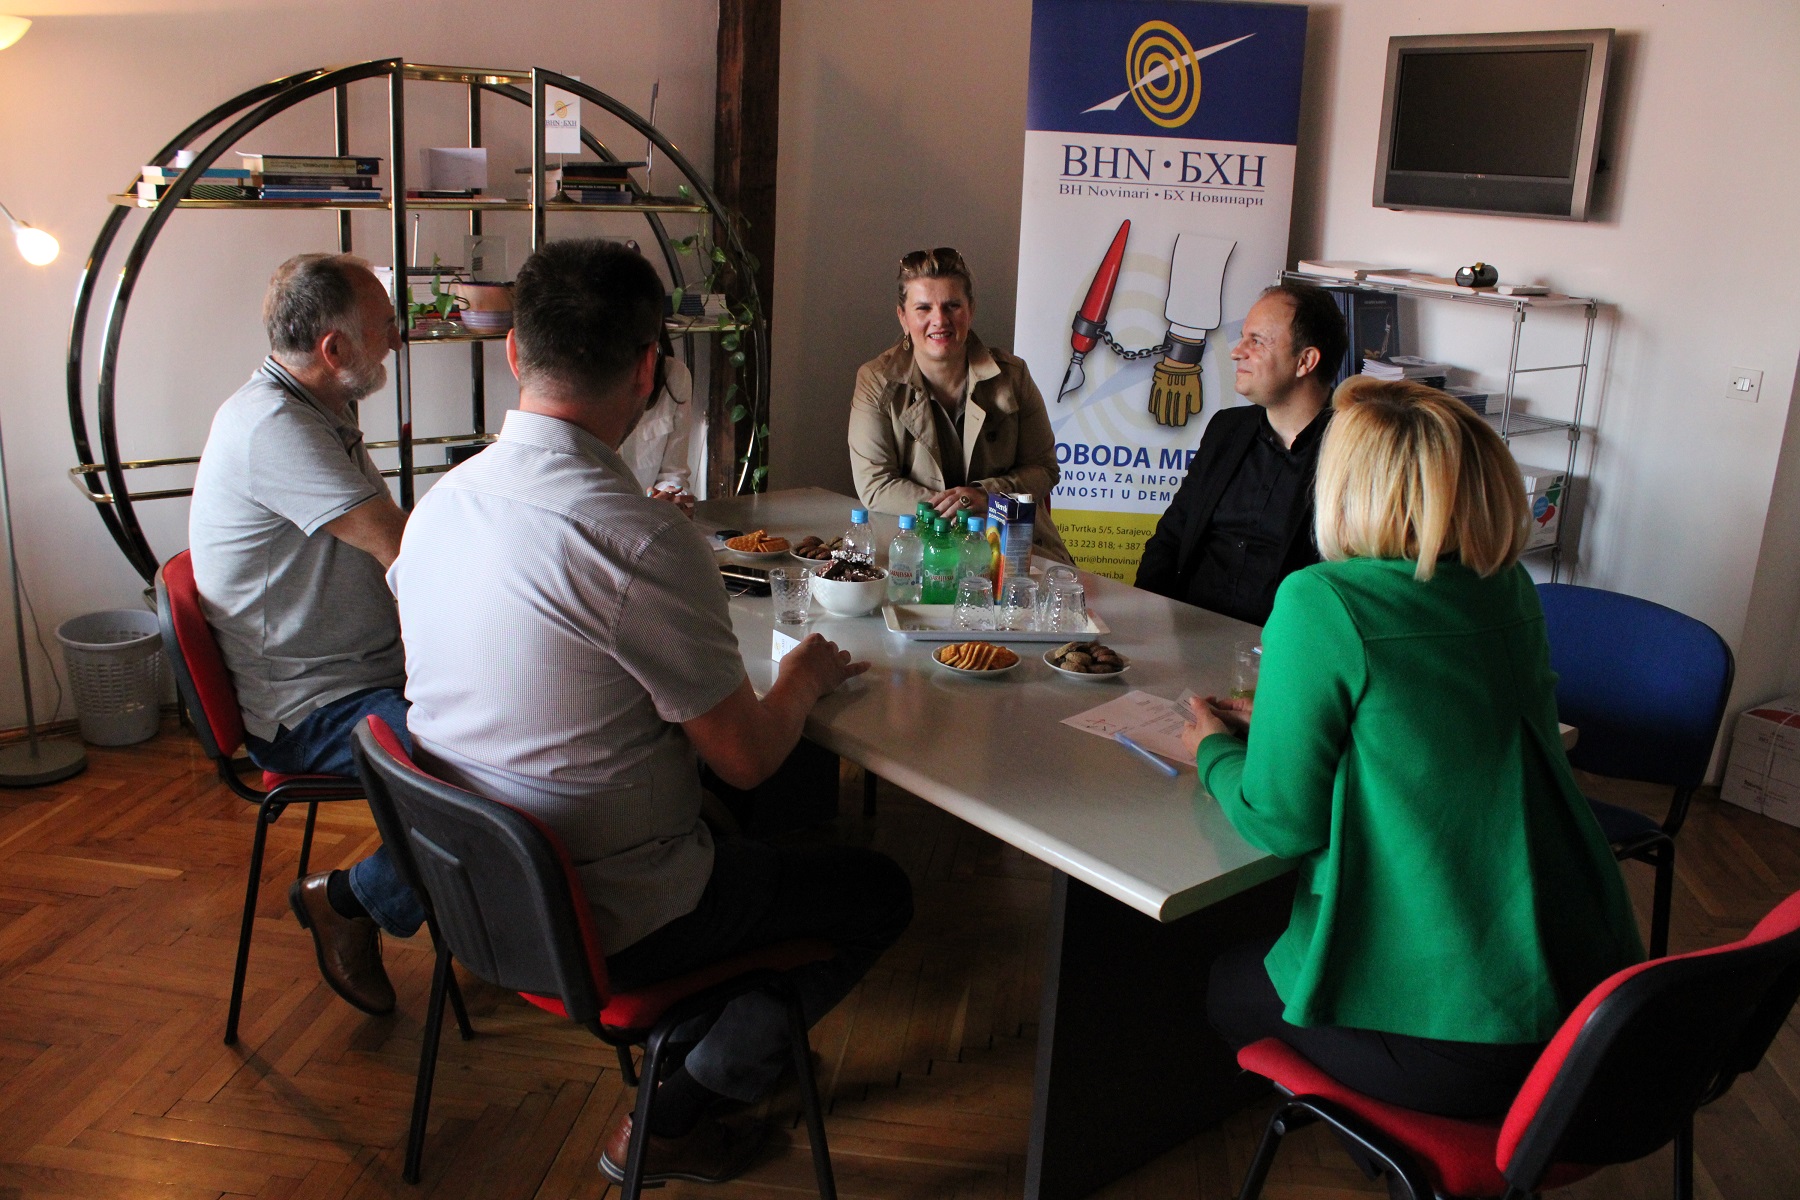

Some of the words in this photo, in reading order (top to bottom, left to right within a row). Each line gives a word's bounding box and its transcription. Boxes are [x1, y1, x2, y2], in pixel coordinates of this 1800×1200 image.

[1060, 144, 1156, 181] BHN
[1177, 150, 1267, 187] БХН
[1060, 184, 1082, 195] BH
[1088, 185, 1149, 199] Novinari
[1163, 189, 1184, 201] БХ
[1190, 191, 1263, 208] Новинари
[1058, 470, 1107, 483] NOVA
[1114, 473, 1133, 484] ZA
[1121, 490, 1130, 499] U
[1138, 490, 1170, 502] DEM
[1071, 523, 1097, 534] Tvrtka
[1098, 525, 1114, 535] 5/5,
[1116, 526, 1153, 537] Sarajevo,
[1068, 539, 1079, 548] 33
[1080, 540, 1096, 549] 223
[1098, 541, 1116, 550] 818;
[1125, 542, 1141, 551] 387
